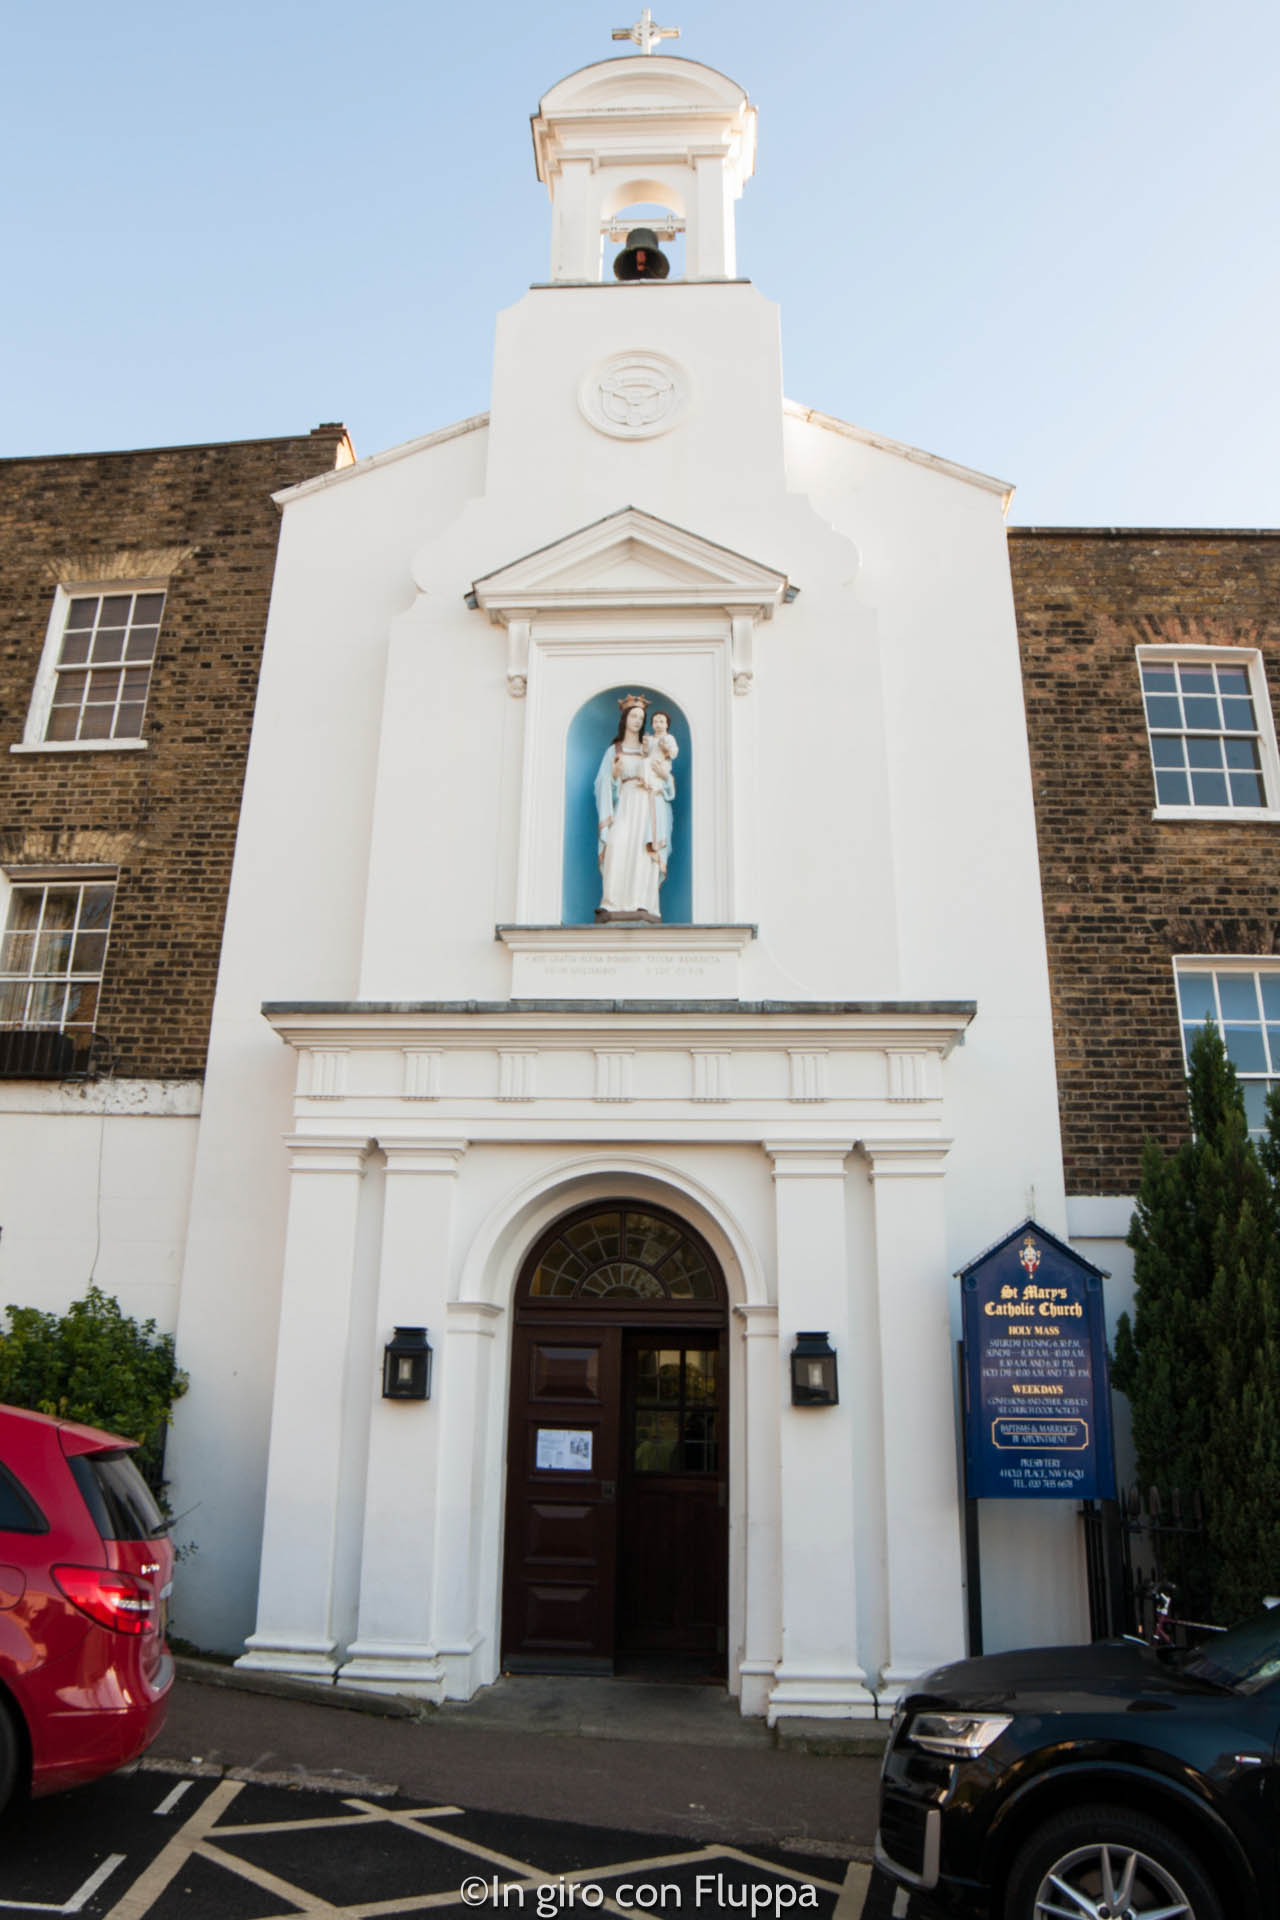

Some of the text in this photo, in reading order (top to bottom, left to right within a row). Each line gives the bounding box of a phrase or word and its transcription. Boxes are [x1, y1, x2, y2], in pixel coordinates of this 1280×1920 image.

[1001, 1285, 1067, 1301] St Mary's
[984, 1301, 1083, 1318] Catholic Church
[1008, 1325, 1060, 1336] HOLY MASS
[1012, 1384, 1064, 1395] WEEKDAYS
